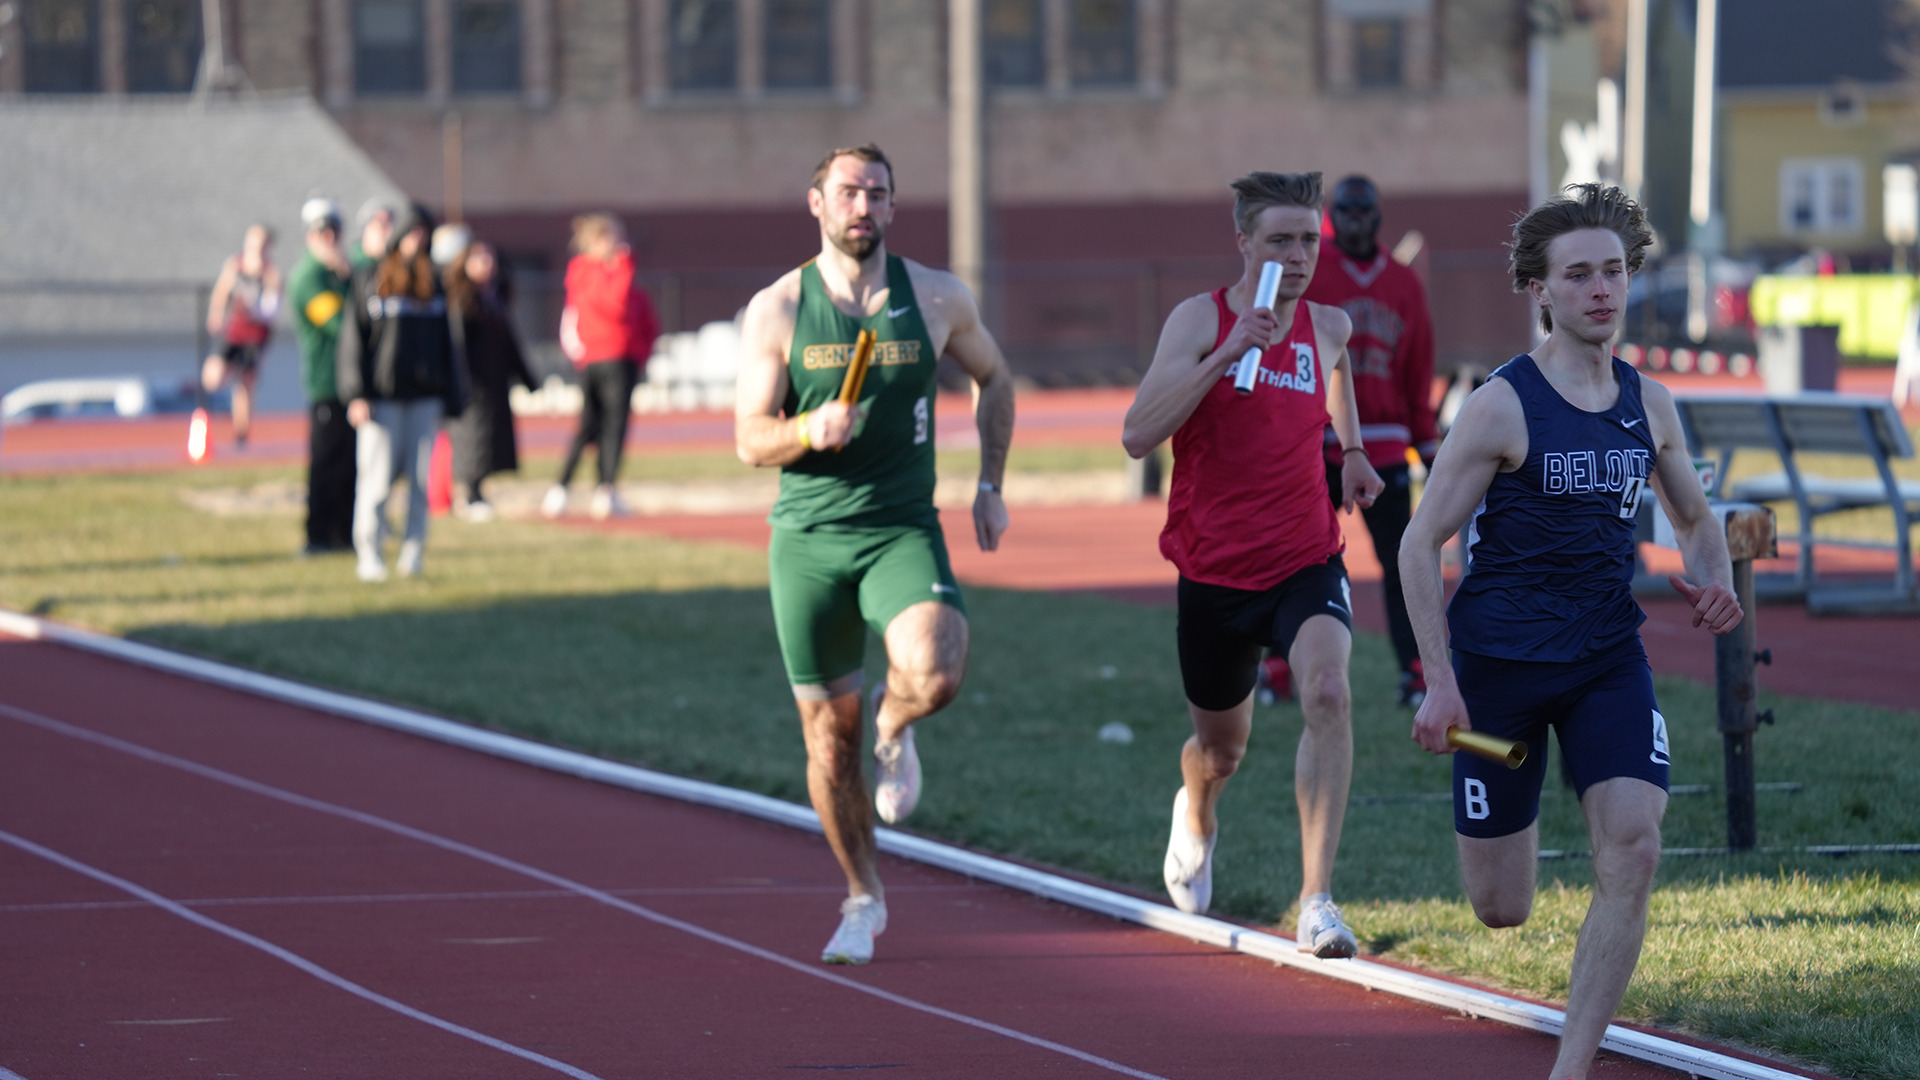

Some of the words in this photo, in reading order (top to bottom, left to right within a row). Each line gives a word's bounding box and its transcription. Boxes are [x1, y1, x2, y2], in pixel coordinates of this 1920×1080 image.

[833, 340, 921, 367] NBERT
[1298, 354, 1311, 383] 3
[1543, 449, 1650, 495] BELOIT
[1622, 479, 1640, 517] 4
[1464, 777, 1491, 820] B
